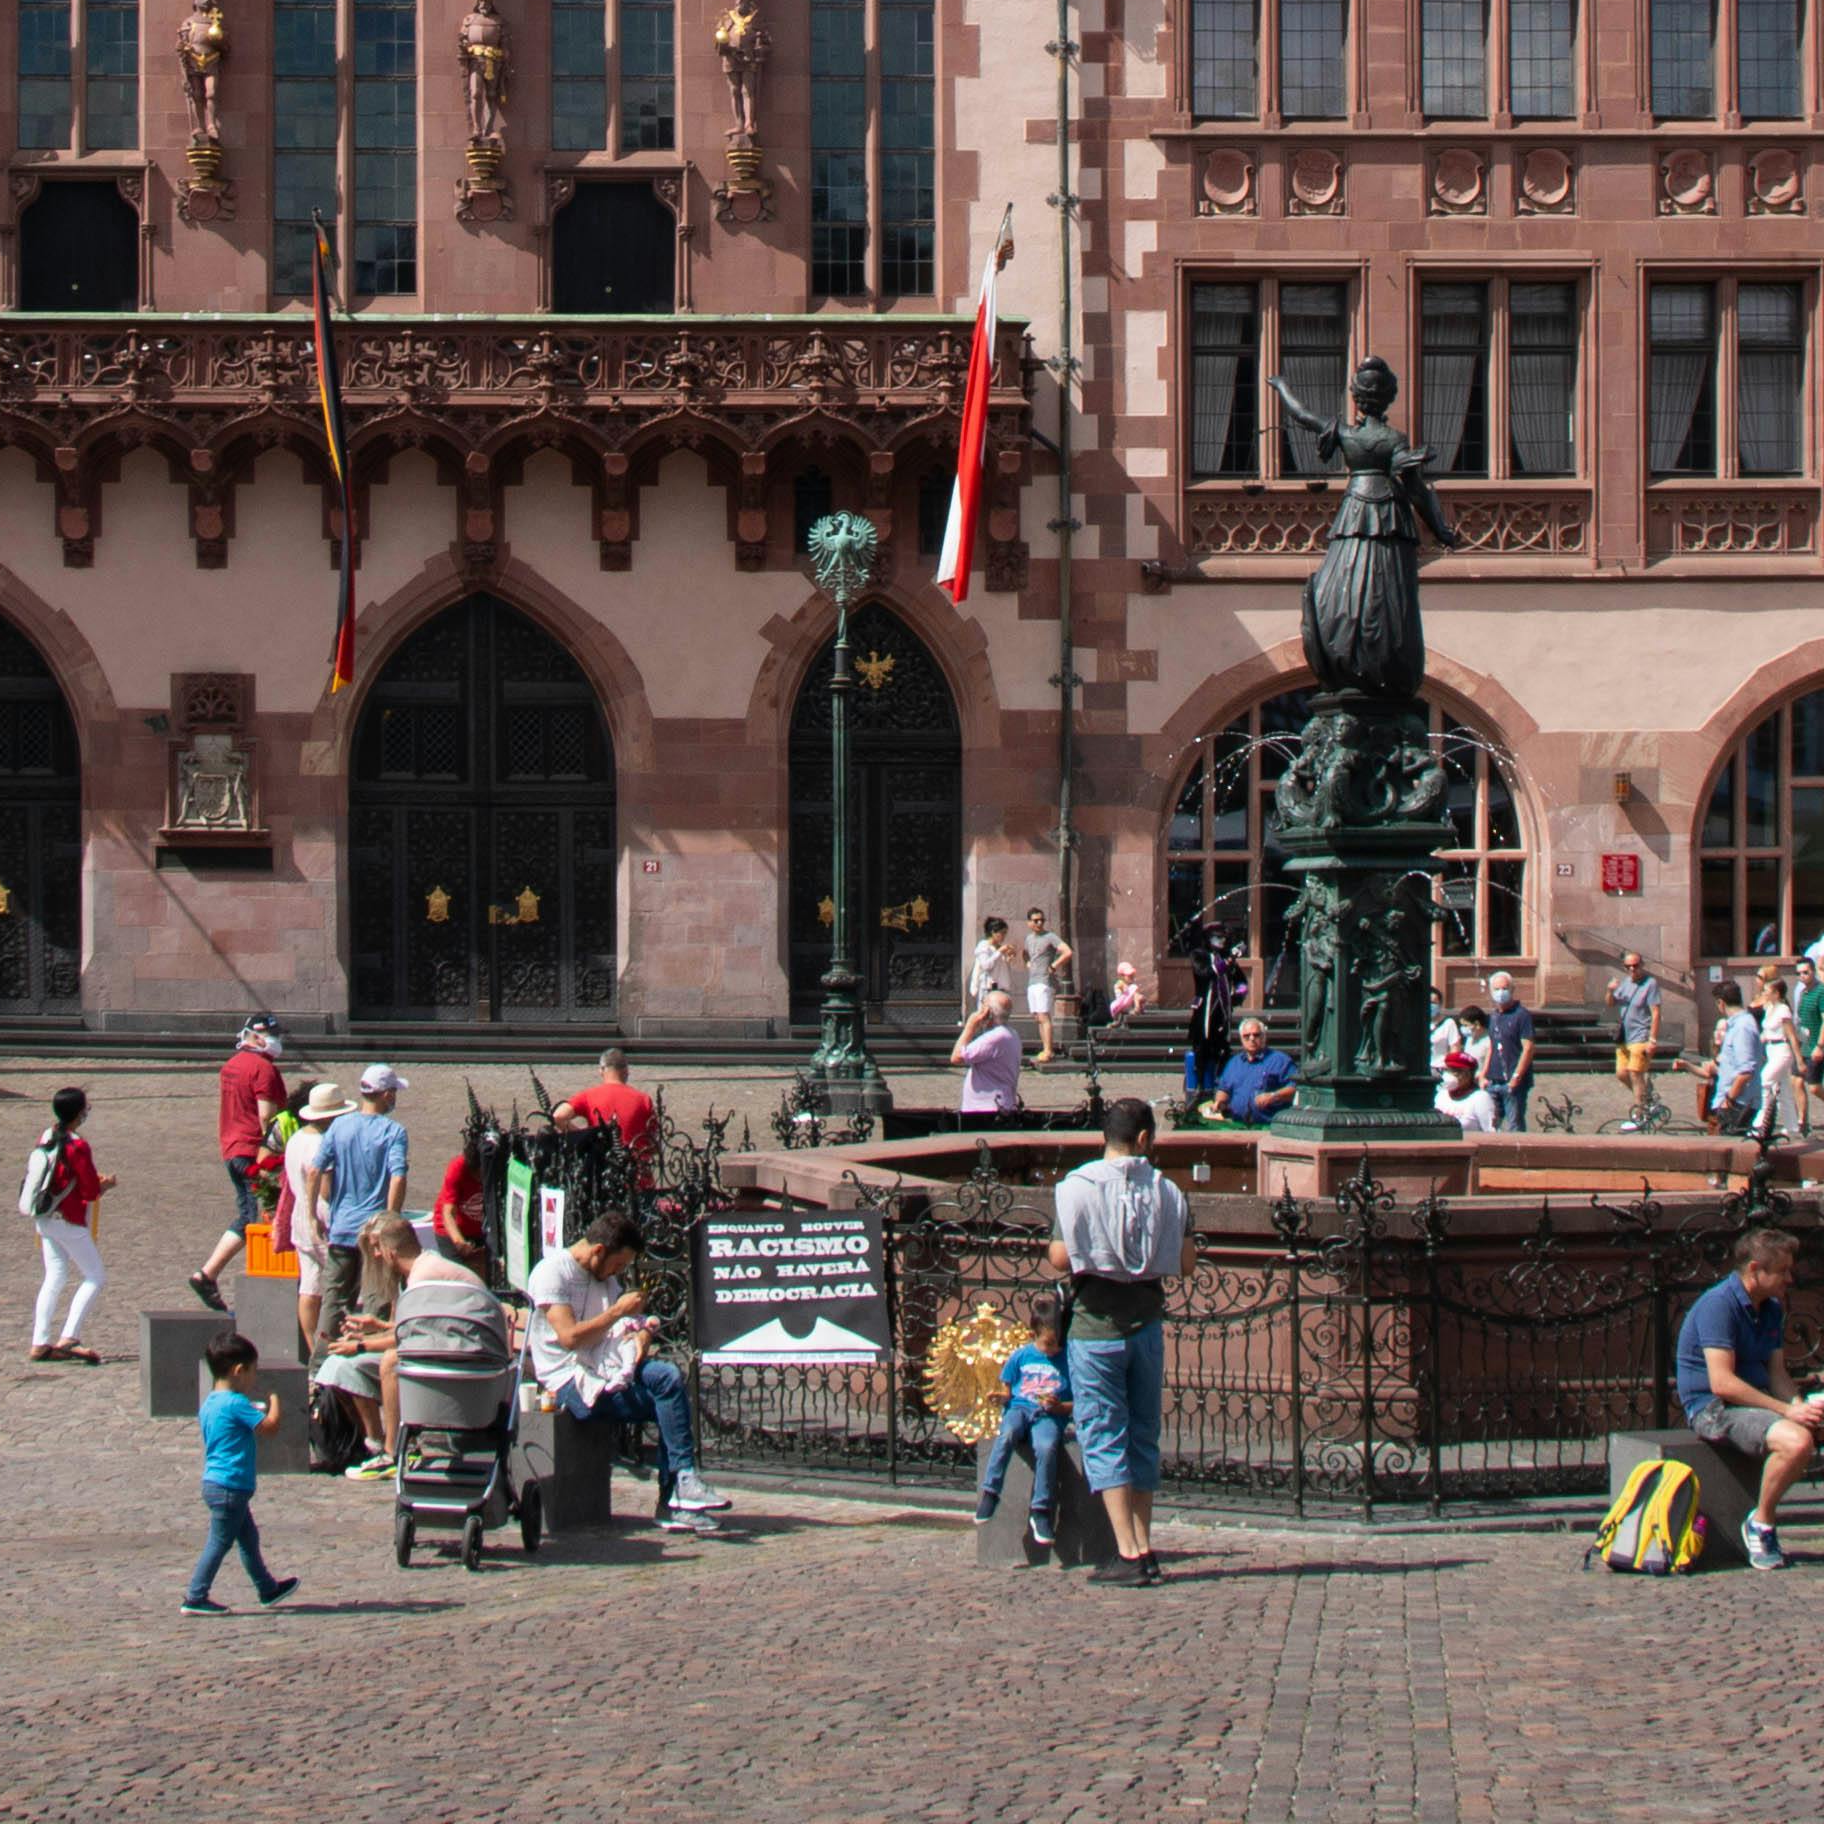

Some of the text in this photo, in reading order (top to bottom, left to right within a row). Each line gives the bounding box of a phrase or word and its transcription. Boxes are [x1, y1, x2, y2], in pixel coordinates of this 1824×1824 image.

[707, 1221, 865, 1234] ENQUANTO HOUVER
[707, 1235, 870, 1258] RACISMO
[715, 1282, 878, 1303] DEMOCRACIA
